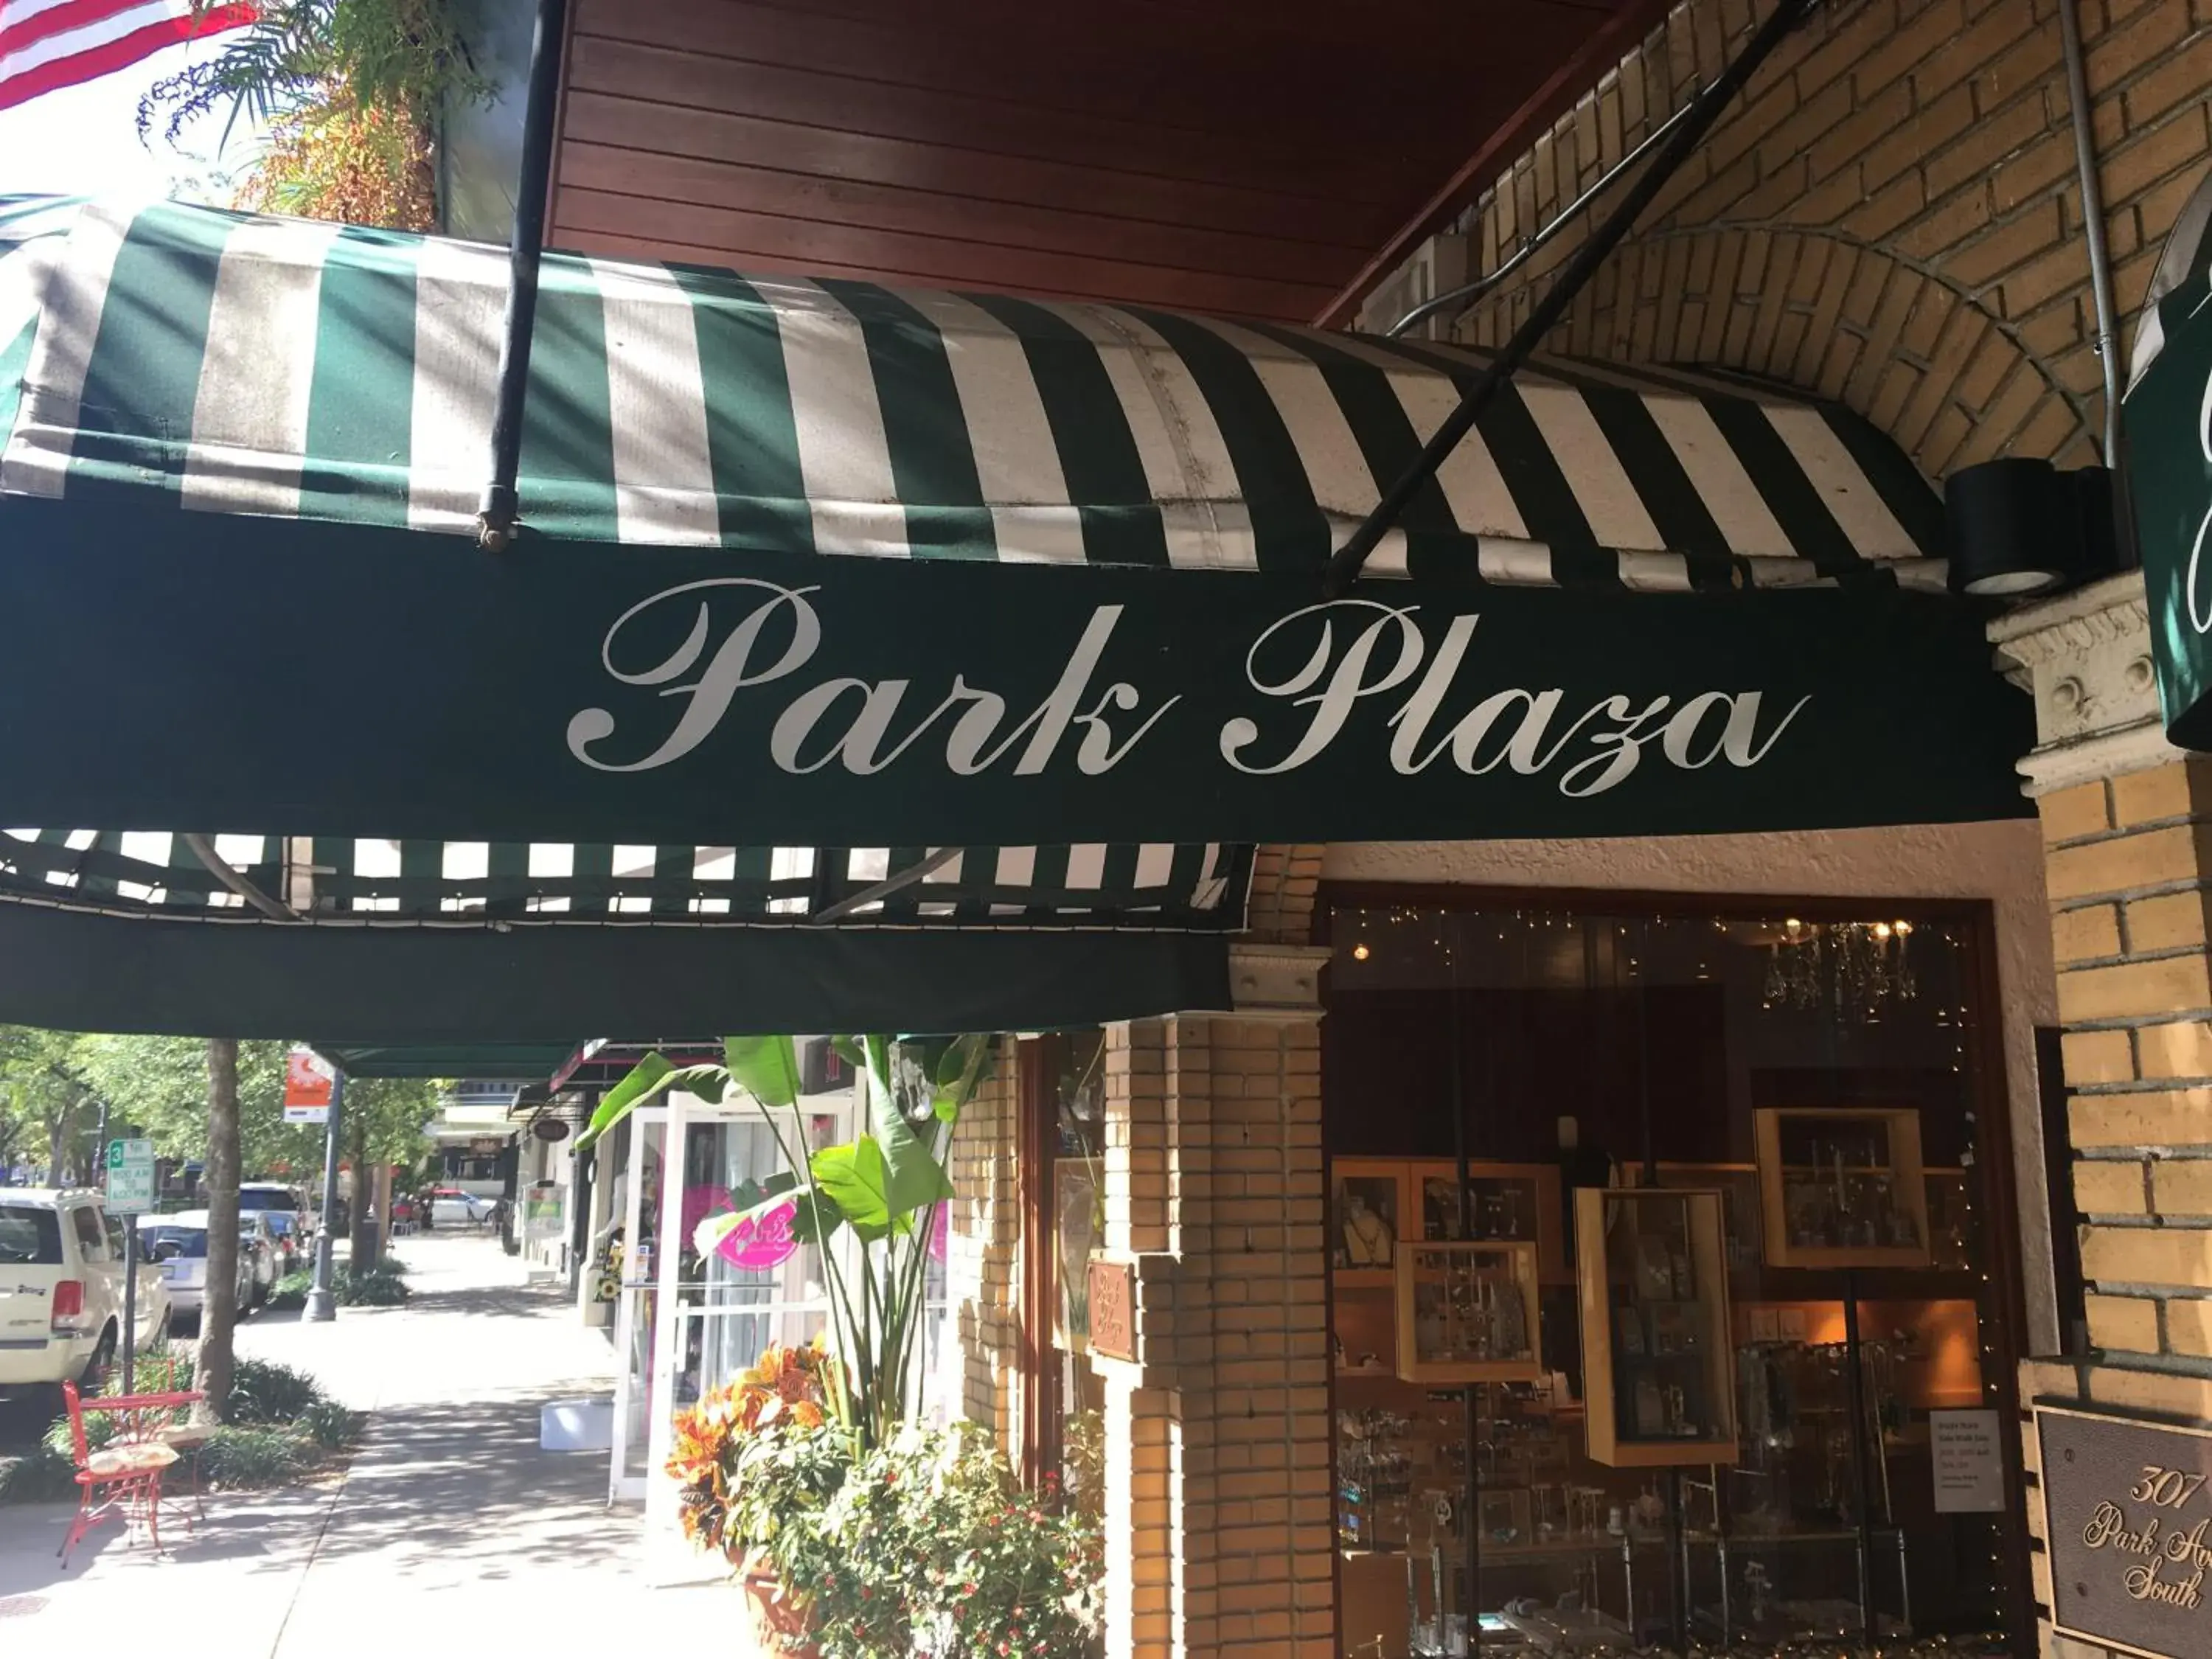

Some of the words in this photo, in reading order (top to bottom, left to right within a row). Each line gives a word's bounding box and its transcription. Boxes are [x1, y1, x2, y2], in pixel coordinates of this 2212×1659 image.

[567, 577, 1182, 776] Park
[1220, 599, 1812, 797] Plaza
[112, 1147, 122, 1163] 3
[2131, 1465, 2207, 1509] 307
[2084, 1500, 2159, 1556] Park
[2166, 1518, 2212, 1571] Av
[2124, 1555, 2203, 1610] South
